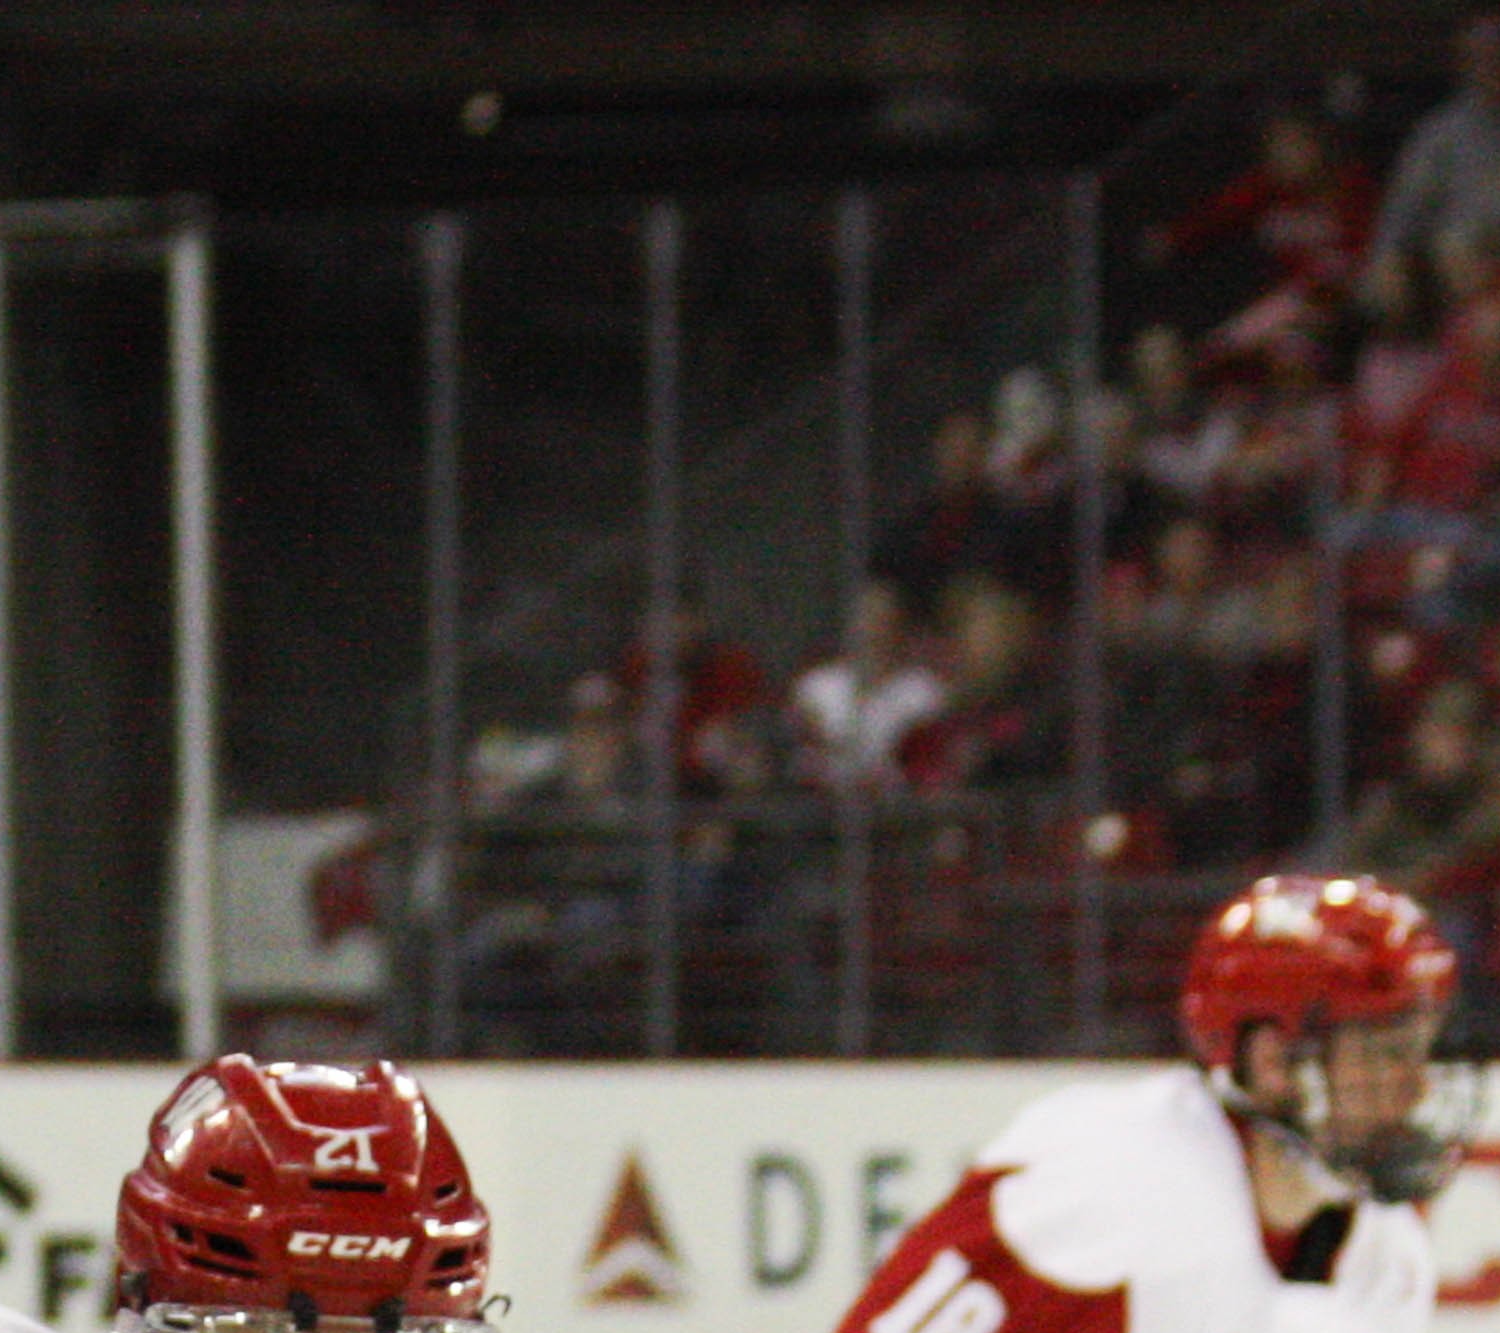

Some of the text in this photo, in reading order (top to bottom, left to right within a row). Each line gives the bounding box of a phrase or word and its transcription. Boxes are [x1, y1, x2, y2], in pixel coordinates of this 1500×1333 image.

[312, 1130, 381, 1173] 21
[745, 1150, 912, 1290] DE
[286, 1230, 414, 1261] CCM
